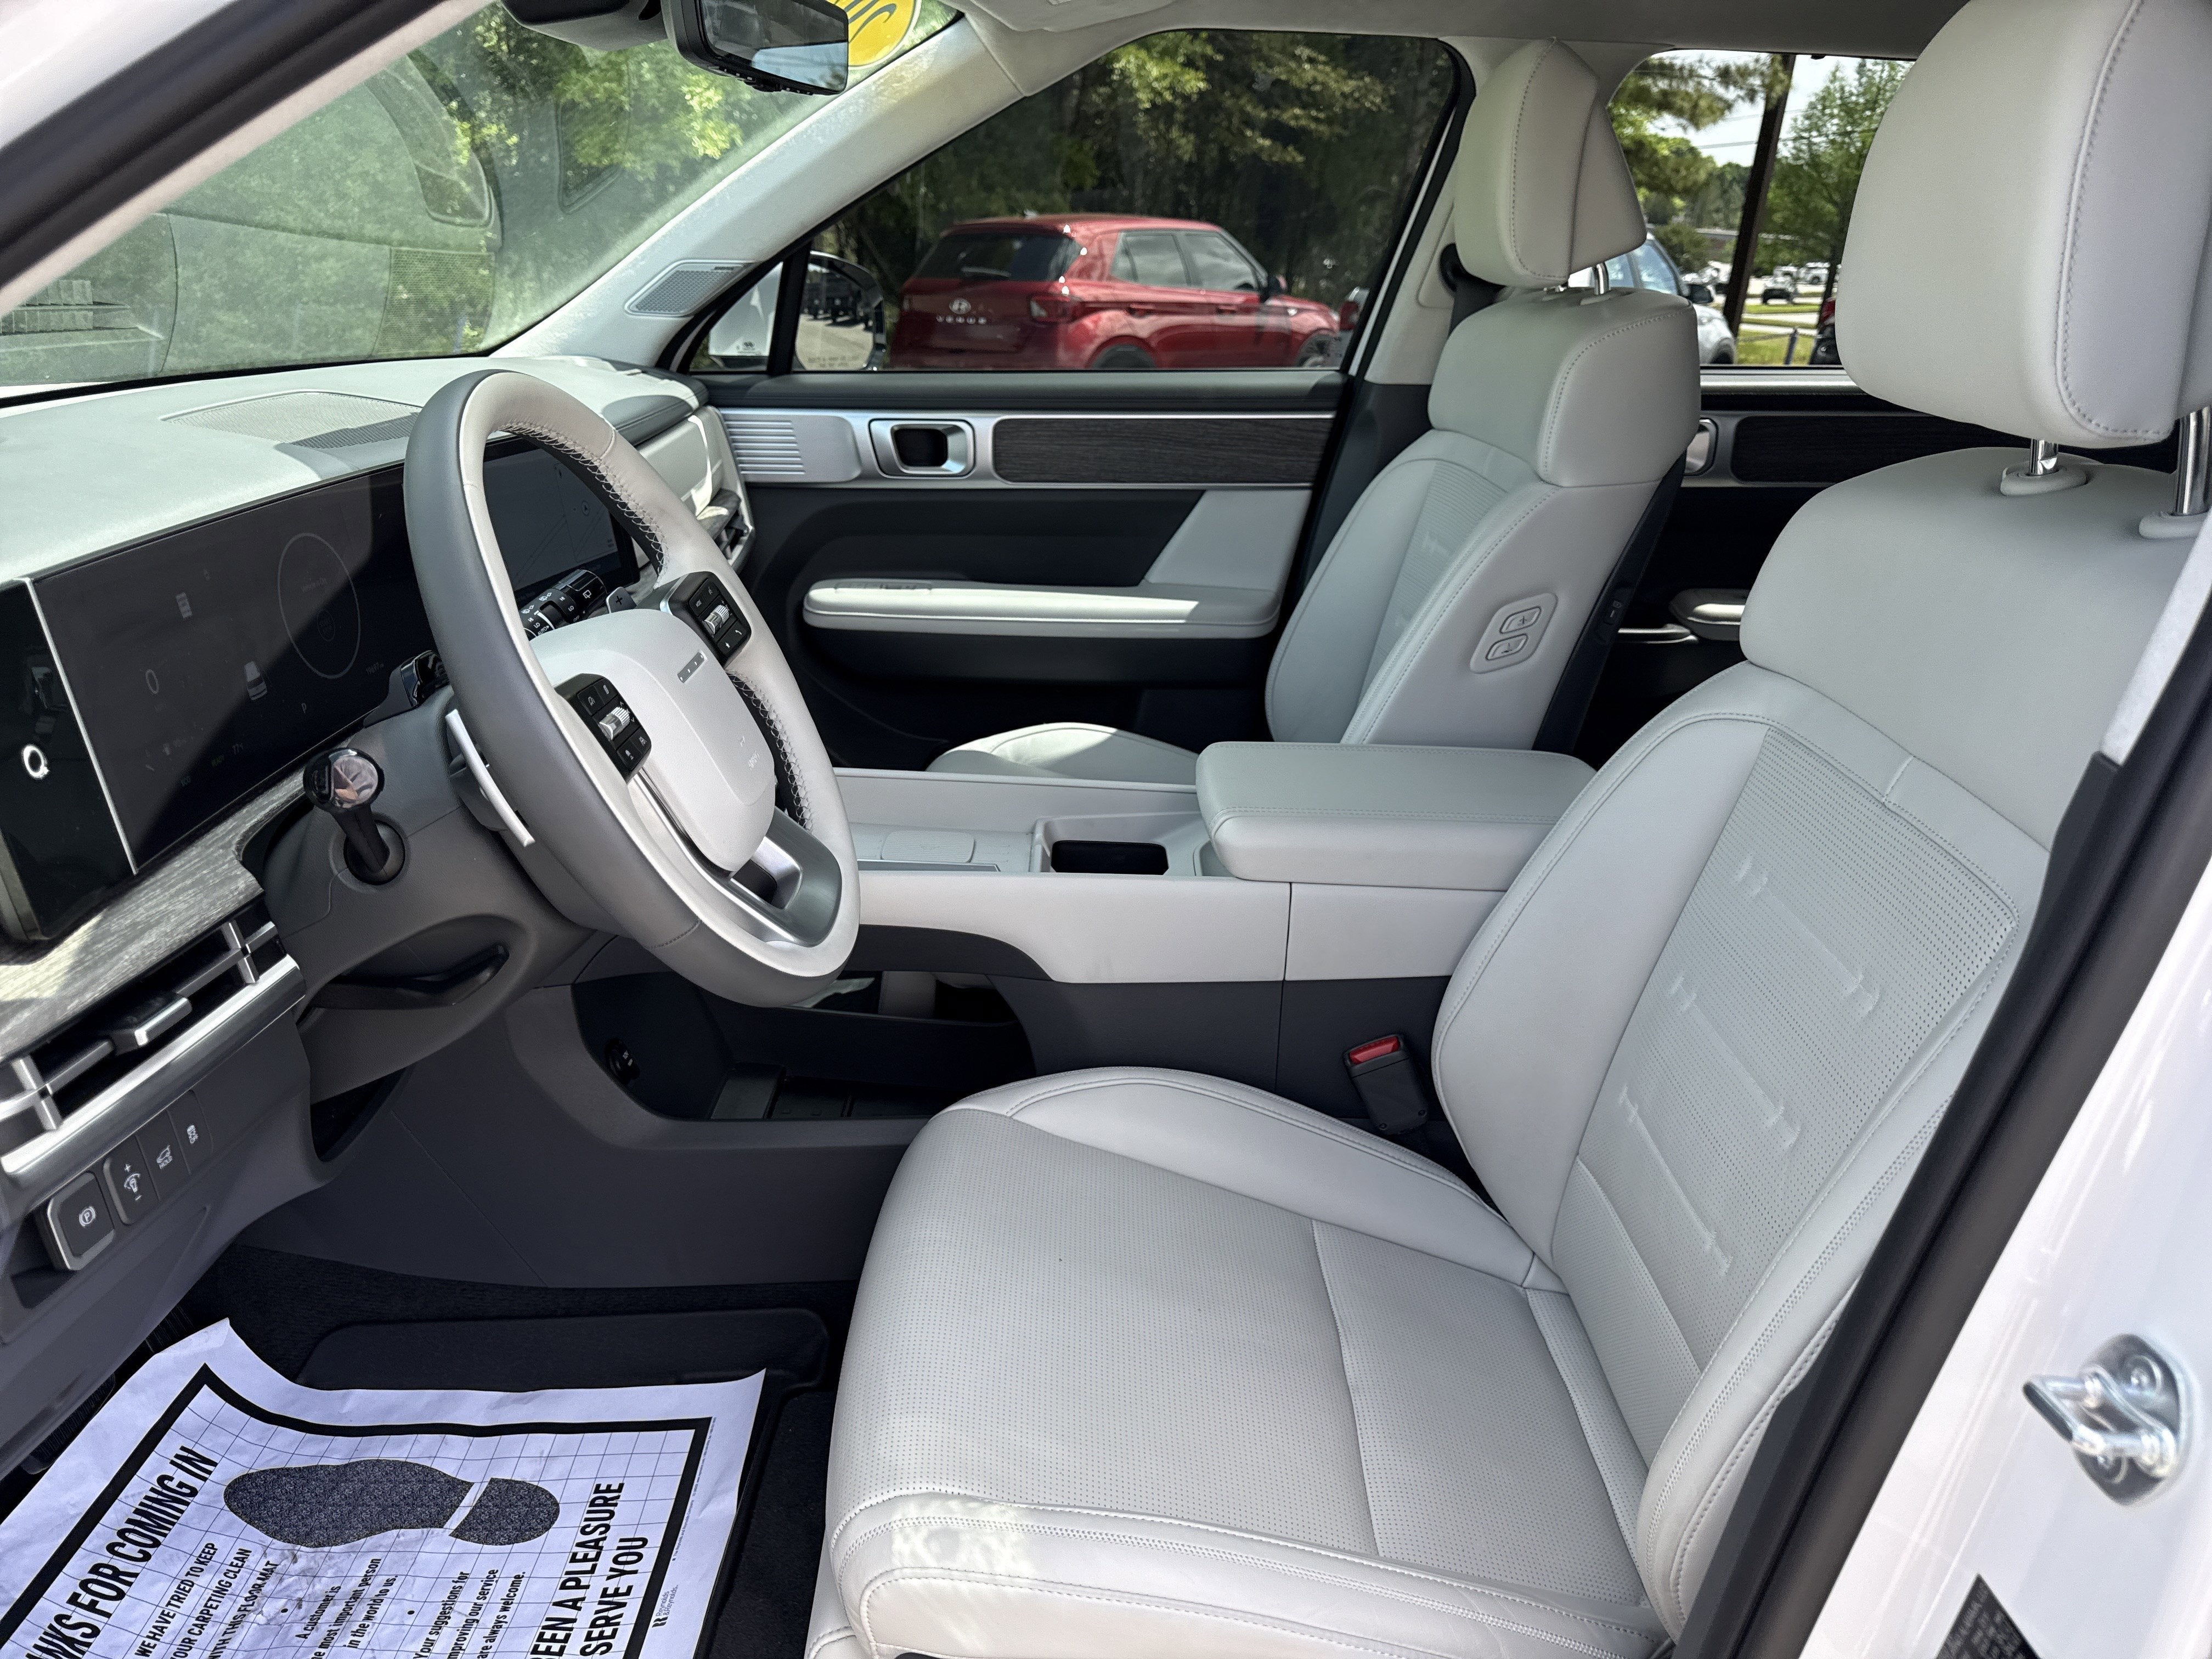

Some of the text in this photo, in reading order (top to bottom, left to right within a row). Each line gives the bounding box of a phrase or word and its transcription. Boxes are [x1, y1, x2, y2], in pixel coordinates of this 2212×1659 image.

[25, 1445, 218, 1659] NKS FOR COMING IN
[469, 1602, 483, 1617] our
[476, 1569, 499, 1600] service
[529, 1482, 625, 1659] EEN A PLEASURE
[134, 1543, 218, 1657] WE HAVE TRIED TO KEEP
[170, 1548, 252, 1659] OUR CARPETING CLEAN
[222, 1613, 246, 1637] THIS
[237, 1582, 267, 1612] FLOOR
[256, 1560, 279, 1581] MAT
[303, 1595, 335, 1632] customer
[325, 1585, 341, 1595] is
[318, 1628, 340, 1649] most
[329, 1588, 365, 1627] important
[358, 1558, 382, 1587] person
[343, 1575, 398, 1649] in the world to us.
[413, 1571, 470, 1659] Your suggestions for
[477, 1571, 526, 1659] are always welcome.
[579, 1537, 648, 1657] SERVE YOU
[656, 1590, 670, 1617] Reynolds
